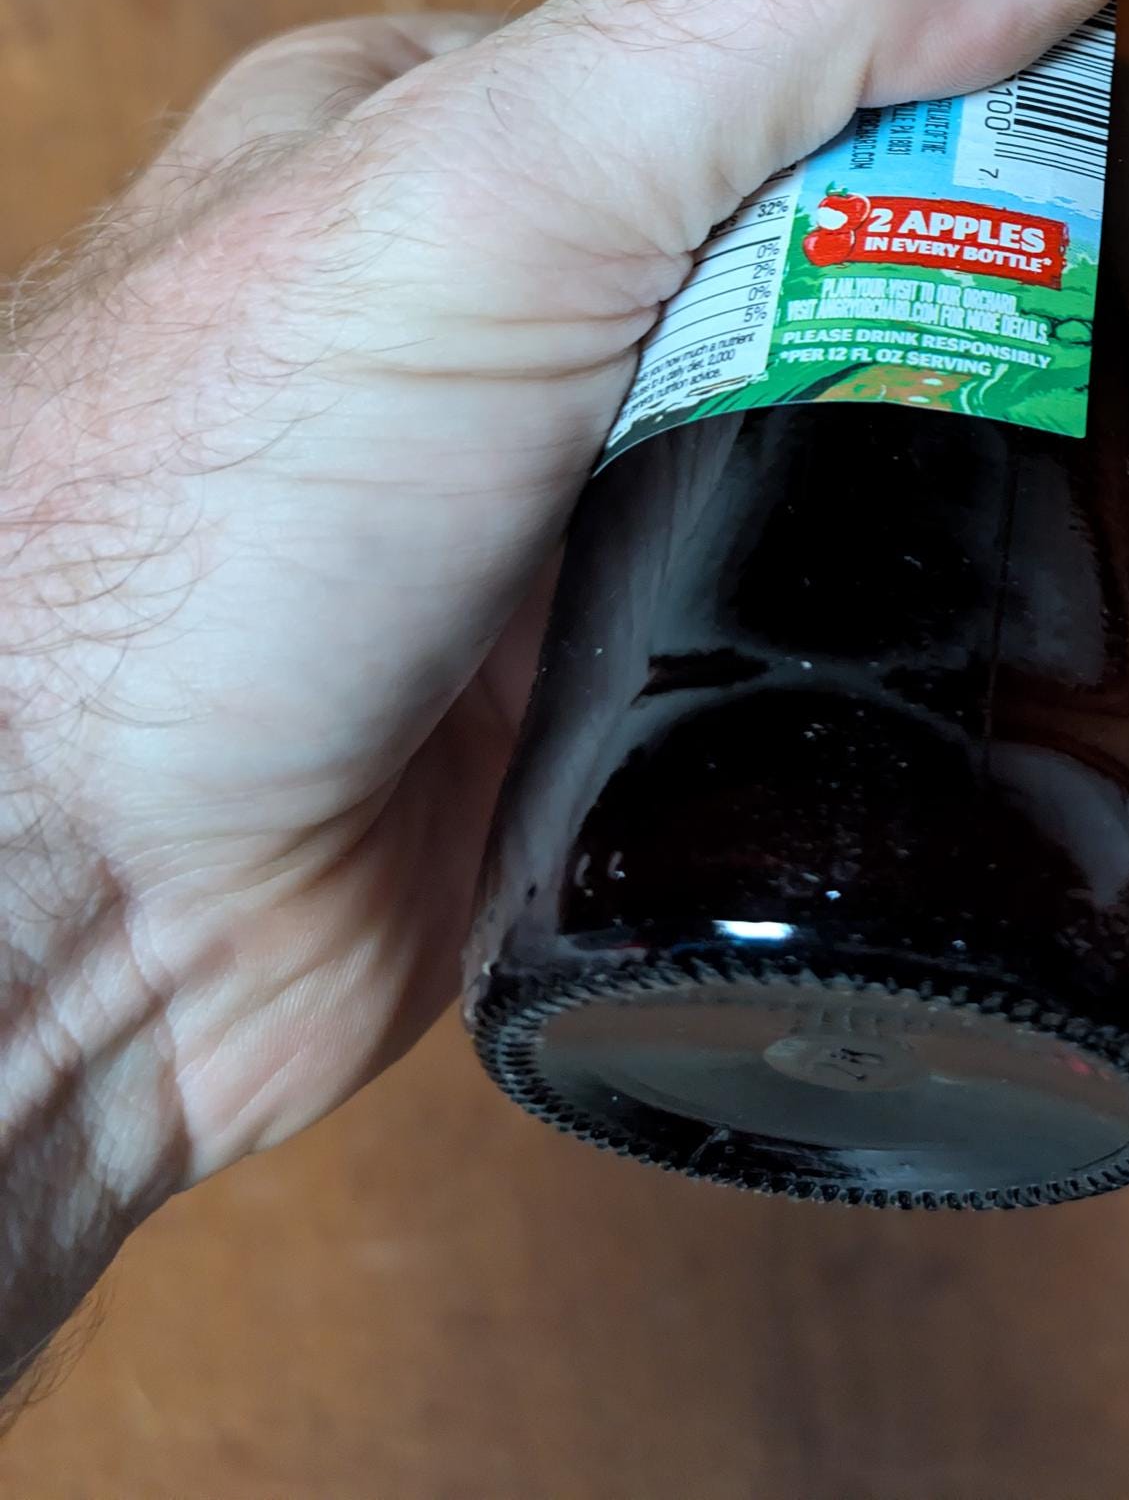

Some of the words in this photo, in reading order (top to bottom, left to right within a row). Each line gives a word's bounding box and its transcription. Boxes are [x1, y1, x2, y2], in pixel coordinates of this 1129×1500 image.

[979, 168, 1000, 179] 7
[757, 198, 789, 218] 32%
[867, 207, 893, 232] 2
[897, 209, 1046, 254] APPLES
[756, 241, 781, 259] 0%
[864, 236, 889, 251] IN
[891, 237, 960, 258] EVERY
[752, 261, 777, 280] 2%
[748, 285, 772, 302] 0%
[743, 305, 768, 323] 5%
[782, 328, 854, 345] PLEASE
[855, 328, 919, 346] DRINK
[920, 333, 1052, 369] RESPONSIBLY
[827, 346, 848, 361] 12
[850, 347, 873, 362] FL
[874, 348, 904, 364] OZ
[905, 351, 992, 376] SERVING
